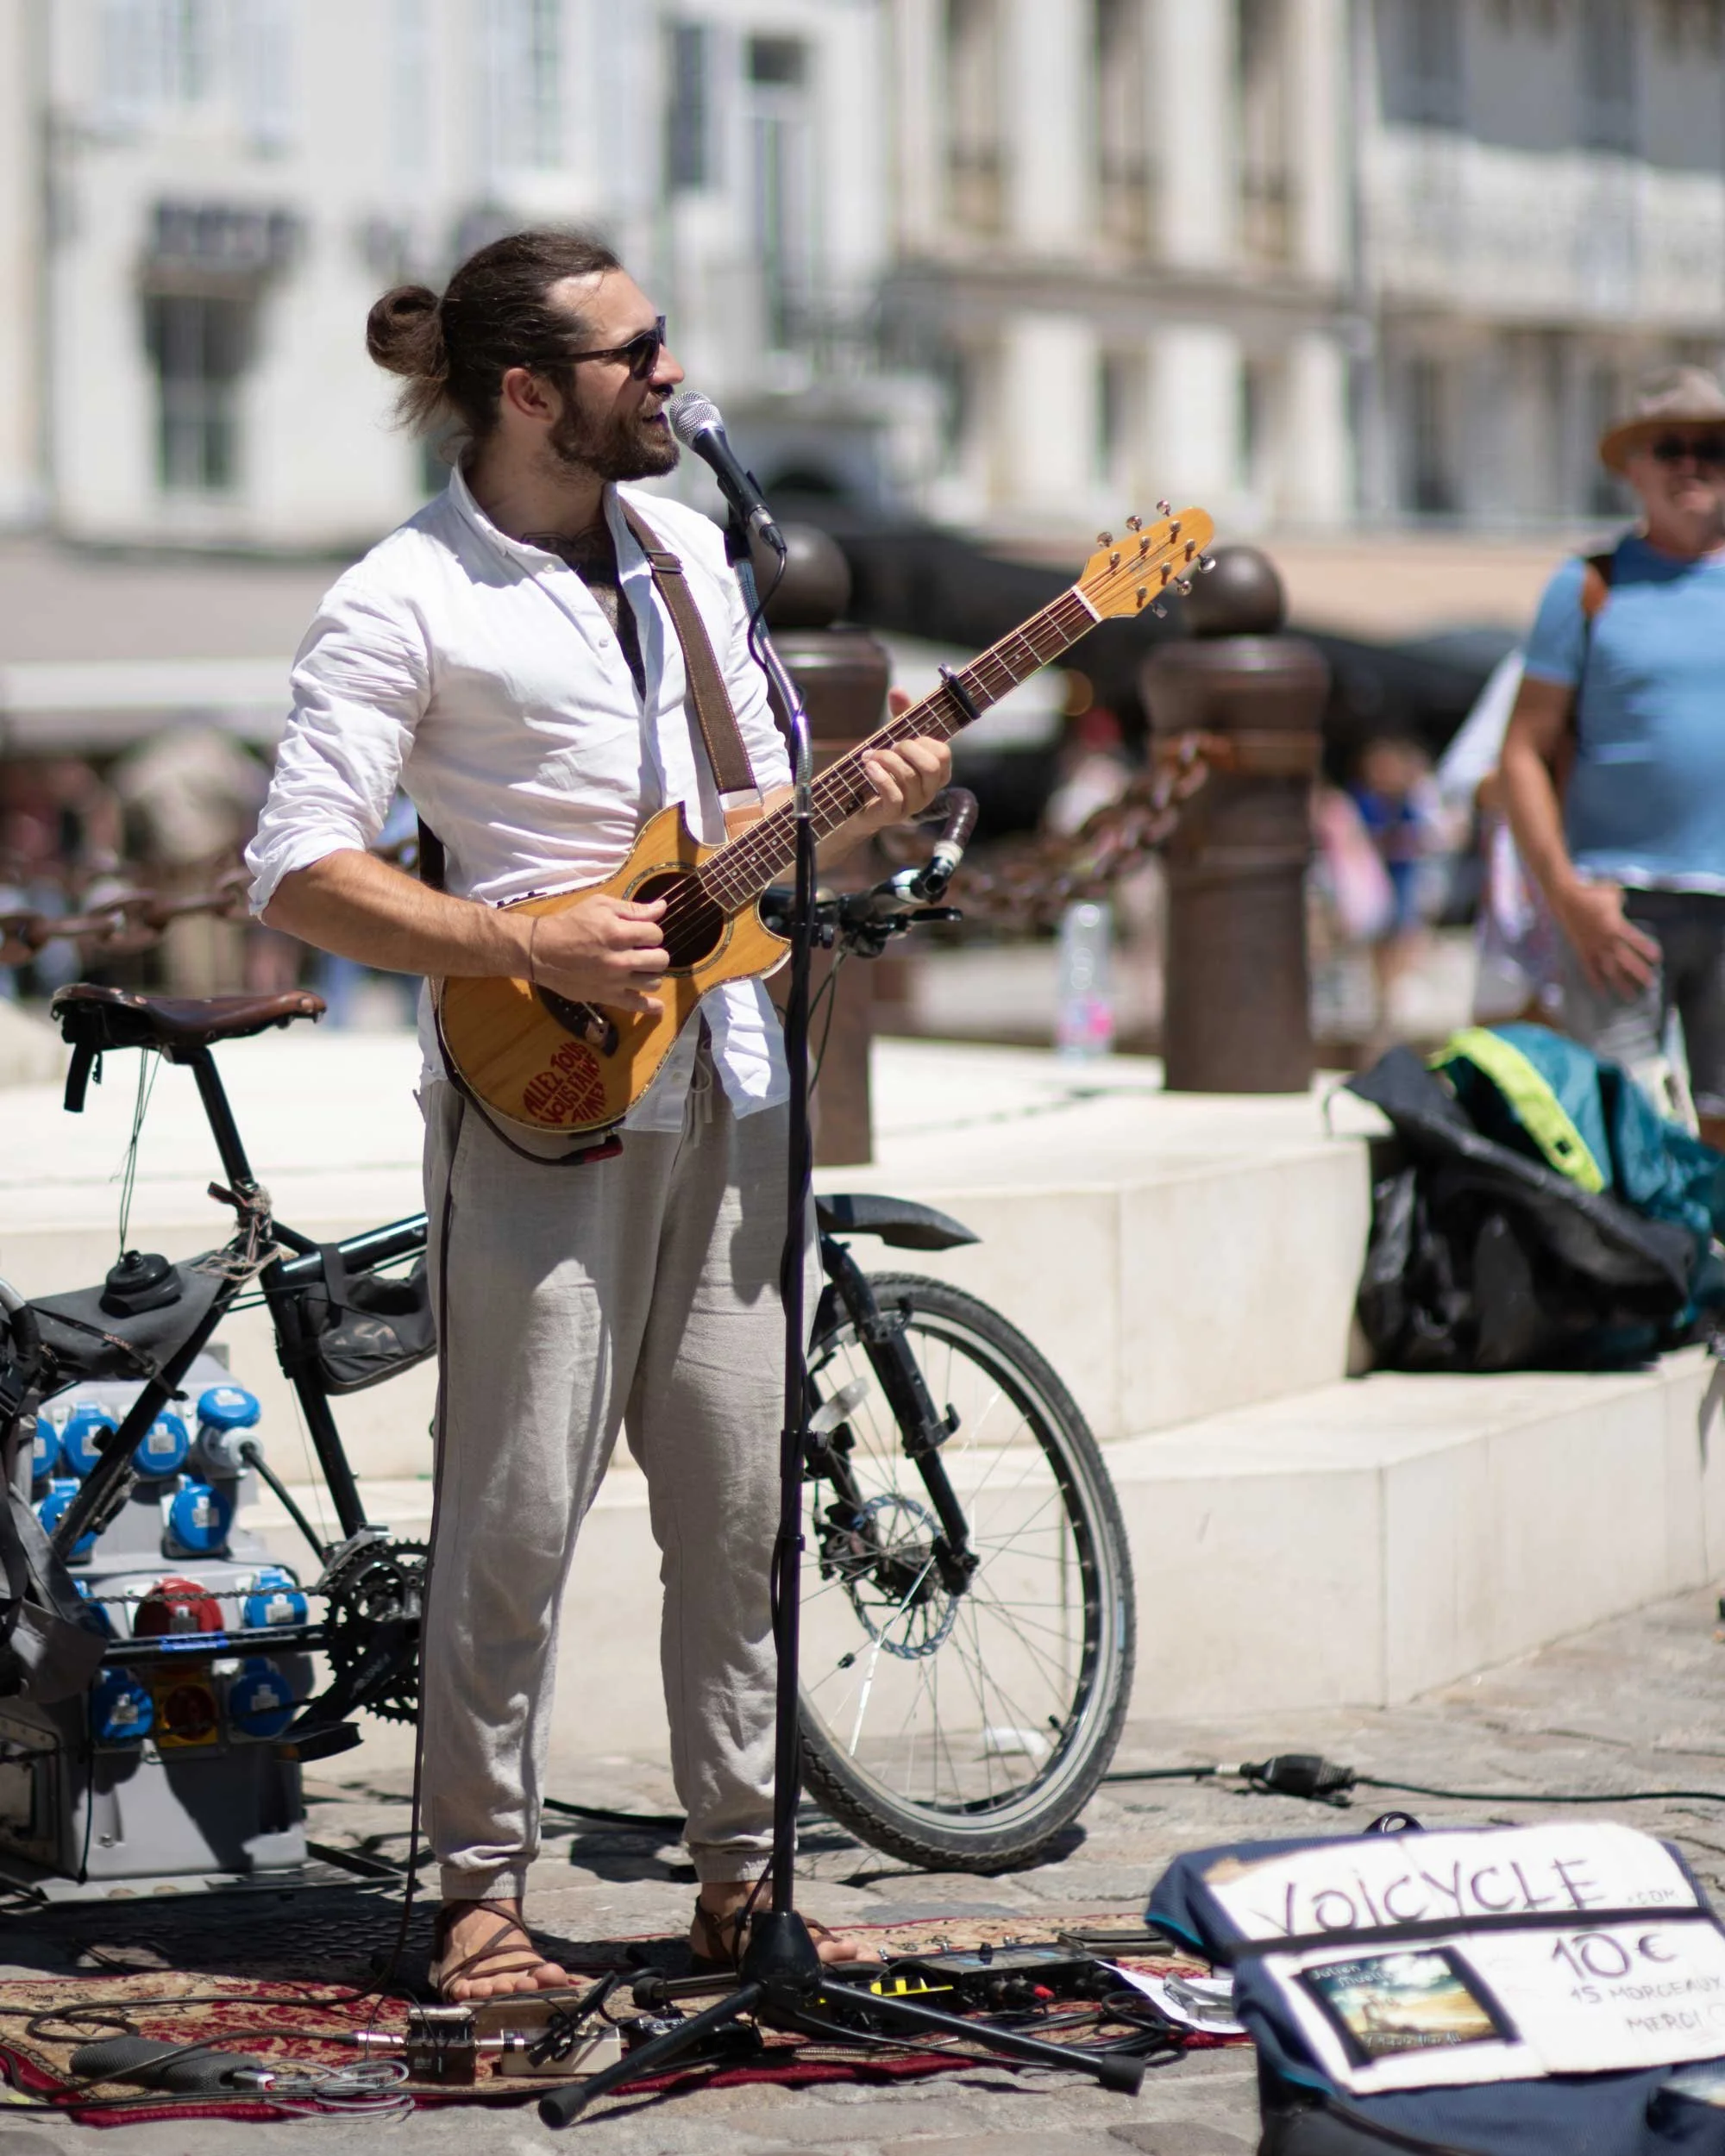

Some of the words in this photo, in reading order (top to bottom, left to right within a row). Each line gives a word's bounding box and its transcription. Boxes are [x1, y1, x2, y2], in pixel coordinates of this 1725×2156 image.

[523, 1071, 564, 1118] ALLEZ
[550, 1042, 588, 1075] TOUS
[538, 1085, 581, 1125] VOUS
[1571, 1984, 1603, 2004] 15
